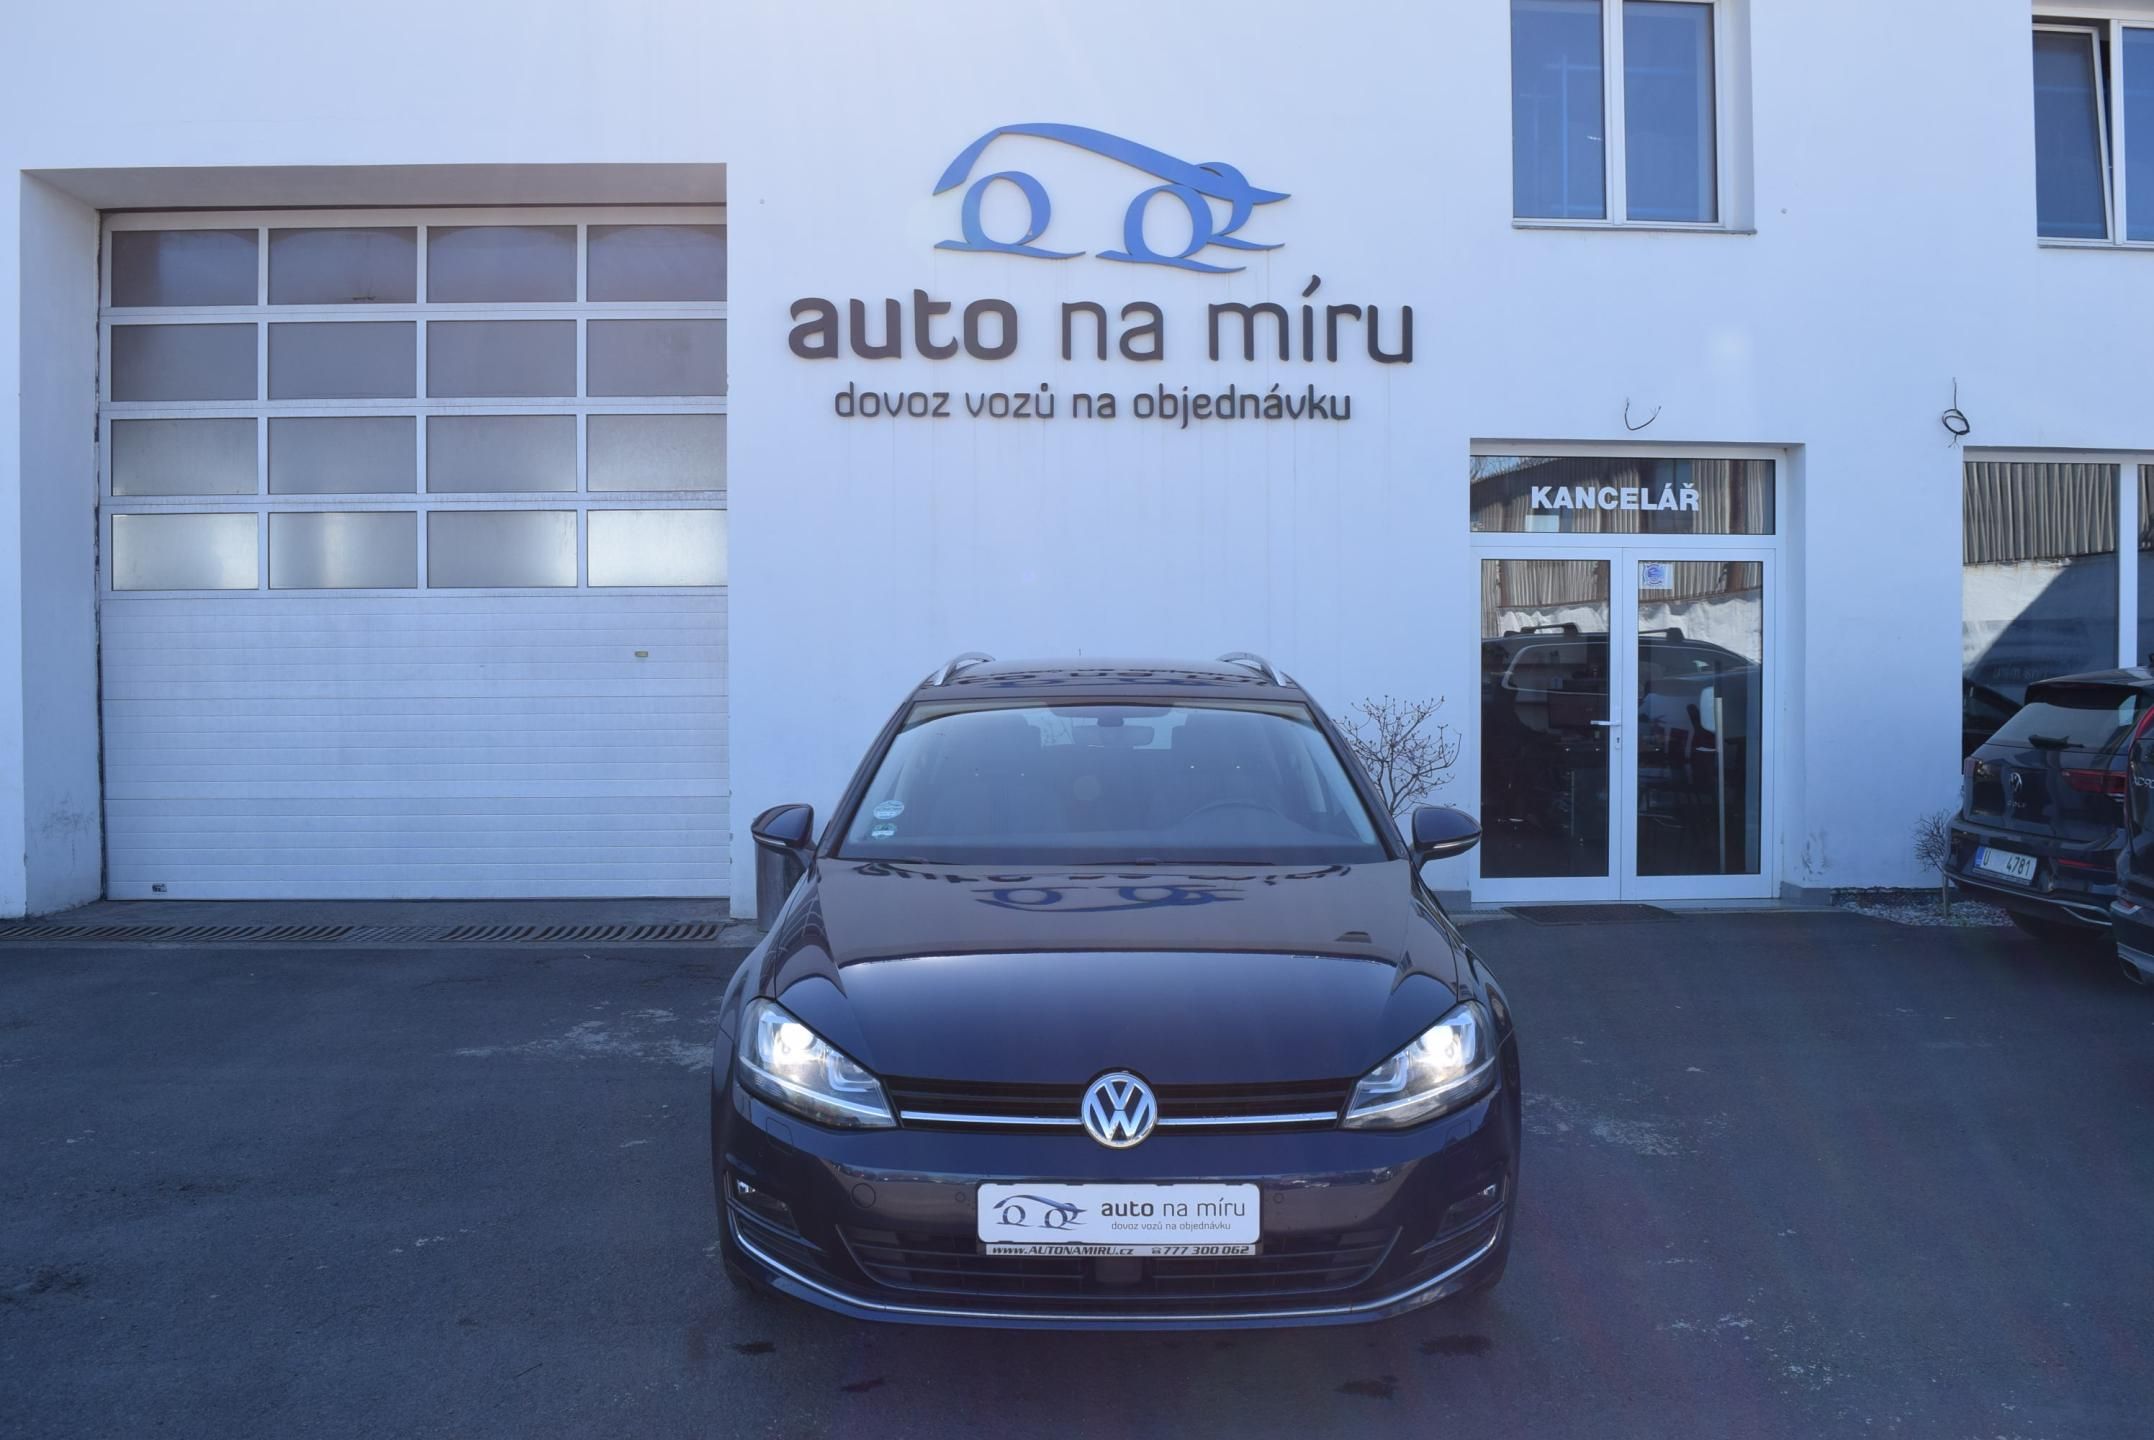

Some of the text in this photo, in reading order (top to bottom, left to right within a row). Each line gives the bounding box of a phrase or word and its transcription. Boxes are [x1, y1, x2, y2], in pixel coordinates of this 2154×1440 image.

[788, 275, 1413, 364] auto na míru
[834, 382, 1351, 429] dovoz vozů na objednávku
[1531, 483, 1700, 512] KANCELÁŘ
[1101, 1197, 1246, 1217] auto na míru
[1111, 1222, 1139, 1230] dovoz
[1141, 1221, 1163, 1230] vozů
[1179, 1221, 1231, 1232] objednávku
[1163, 1246, 1190, 1255] 777
[1191, 1246, 1219, 1255] 300
[1221, 1246, 1250, 1255] 062
